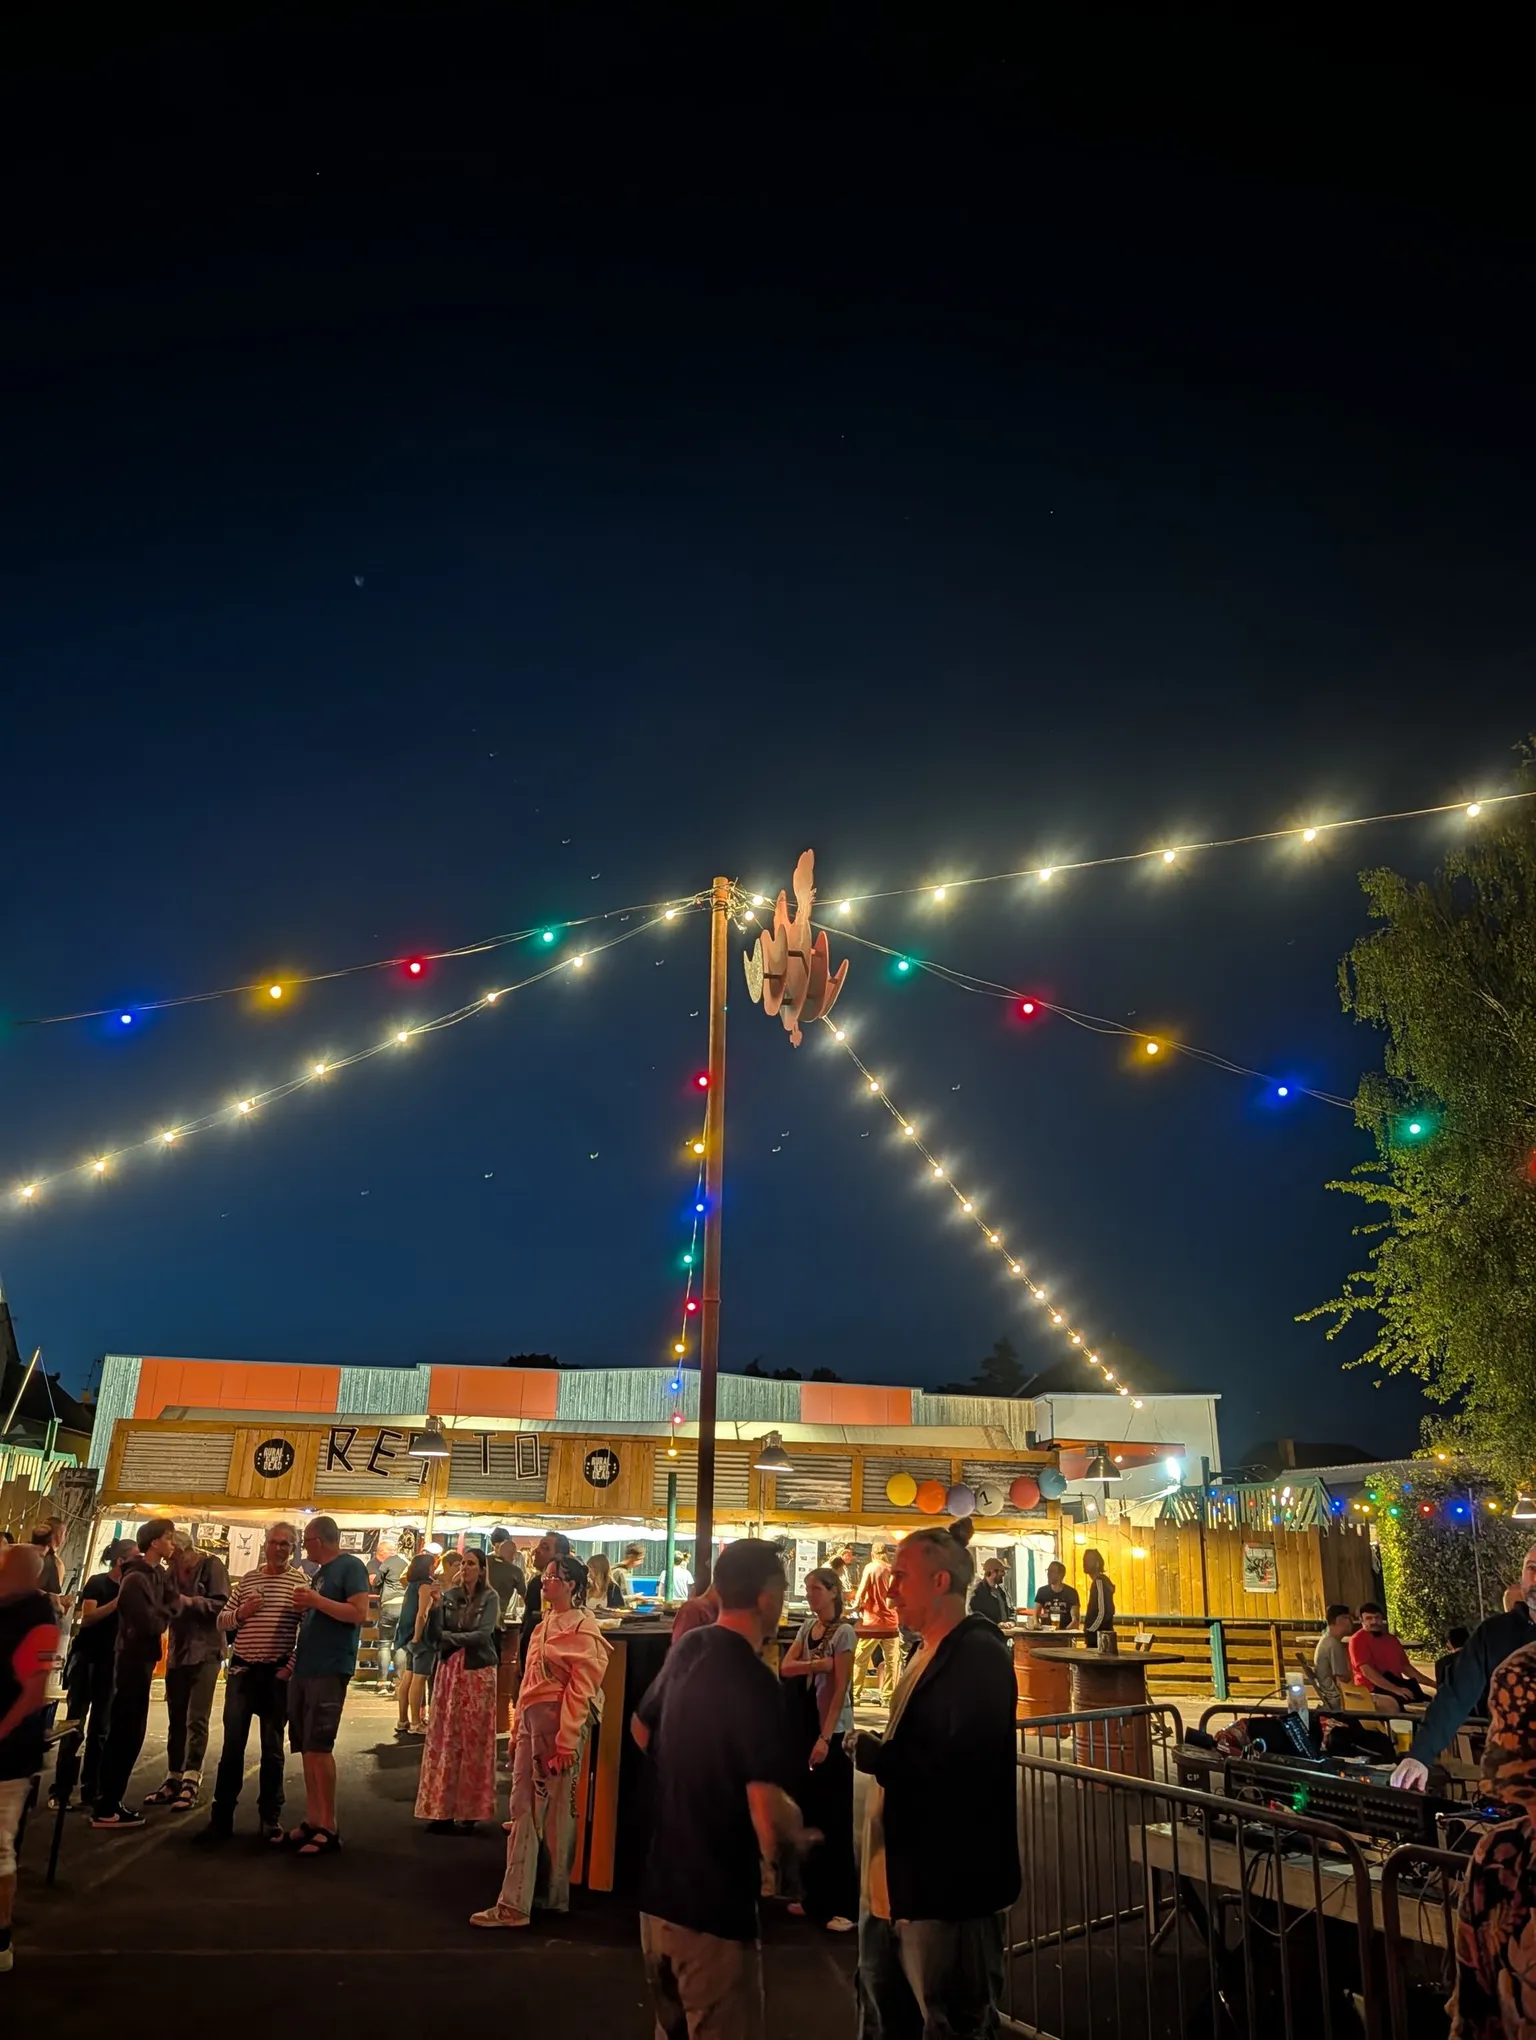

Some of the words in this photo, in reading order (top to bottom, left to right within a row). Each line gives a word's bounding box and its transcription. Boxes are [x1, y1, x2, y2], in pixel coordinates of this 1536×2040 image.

[263, 1447, 284, 1458] RURAL
[263, 1461, 283, 1470] DEAD
[591, 1456, 611, 1466] RURAL
[592, 1470, 610, 1480] DEAD
[979, 1490, 992, 1506] 1
